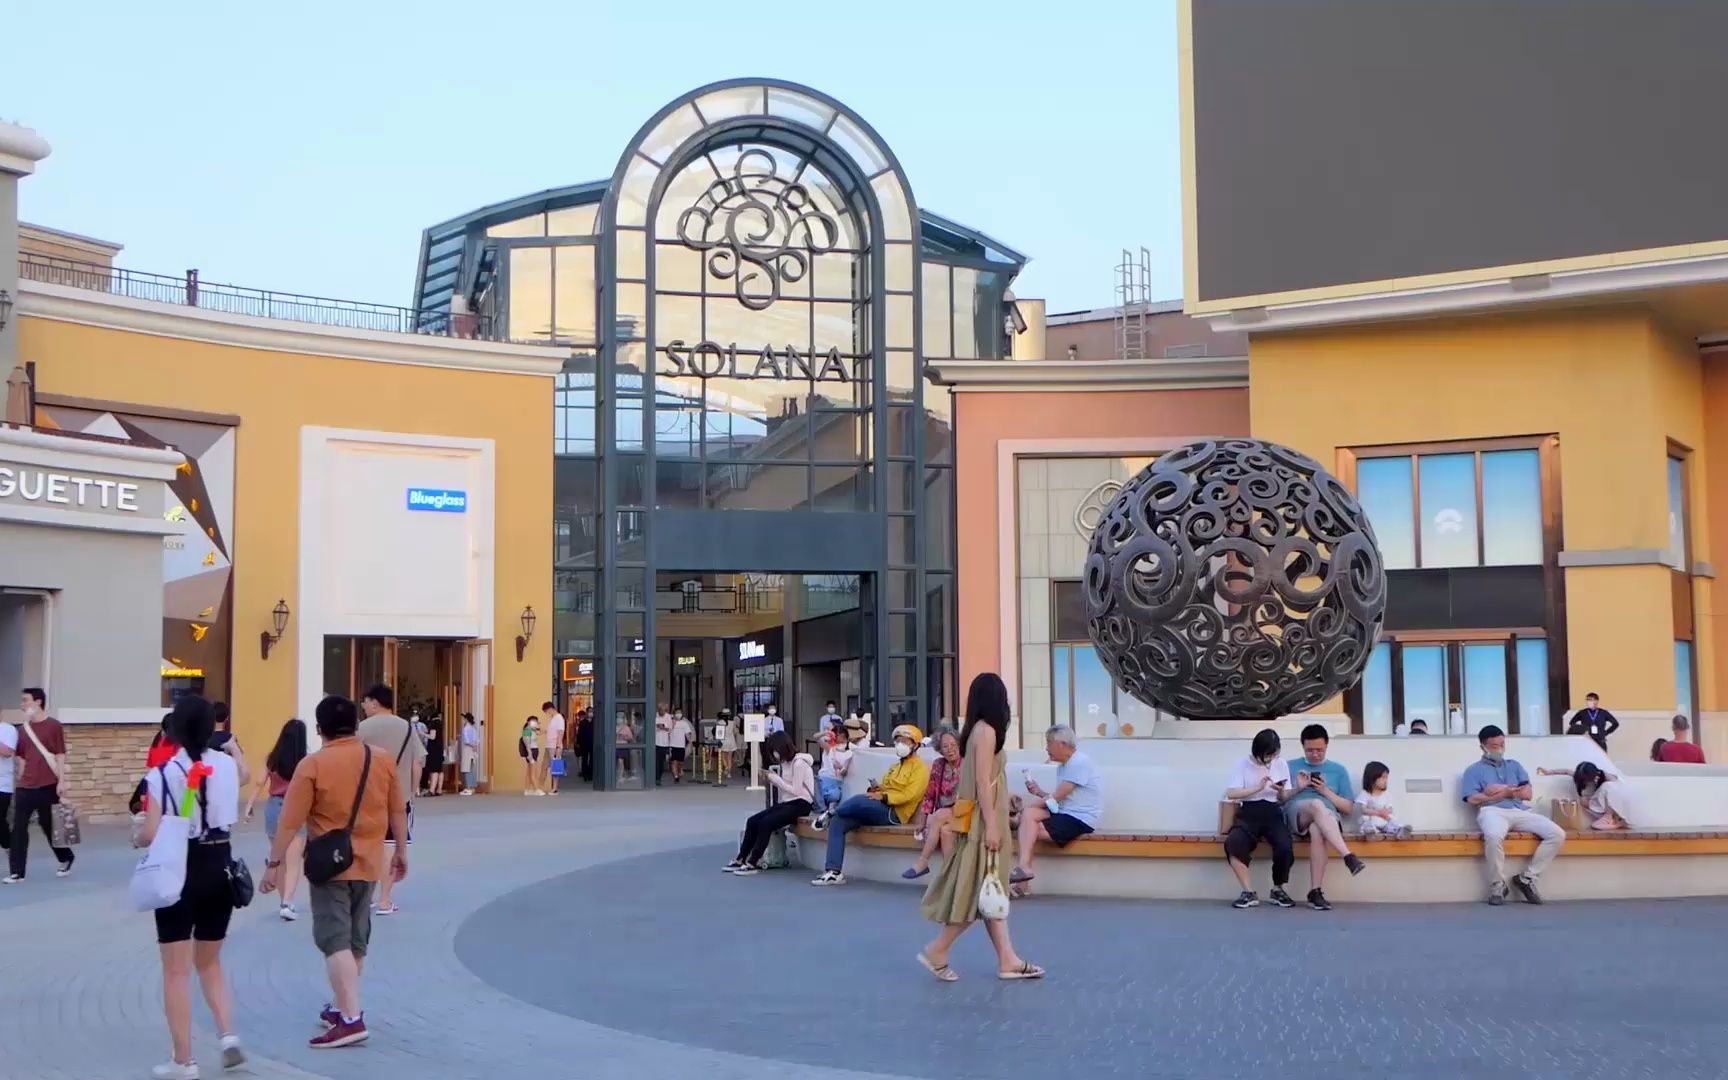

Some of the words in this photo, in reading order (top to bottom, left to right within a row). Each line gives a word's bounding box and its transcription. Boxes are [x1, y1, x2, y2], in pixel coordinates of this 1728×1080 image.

[665, 339, 850, 383] SOLANA
[0, 467, 139, 512] GUETTE
[409, 490, 465, 509] Blueglass
